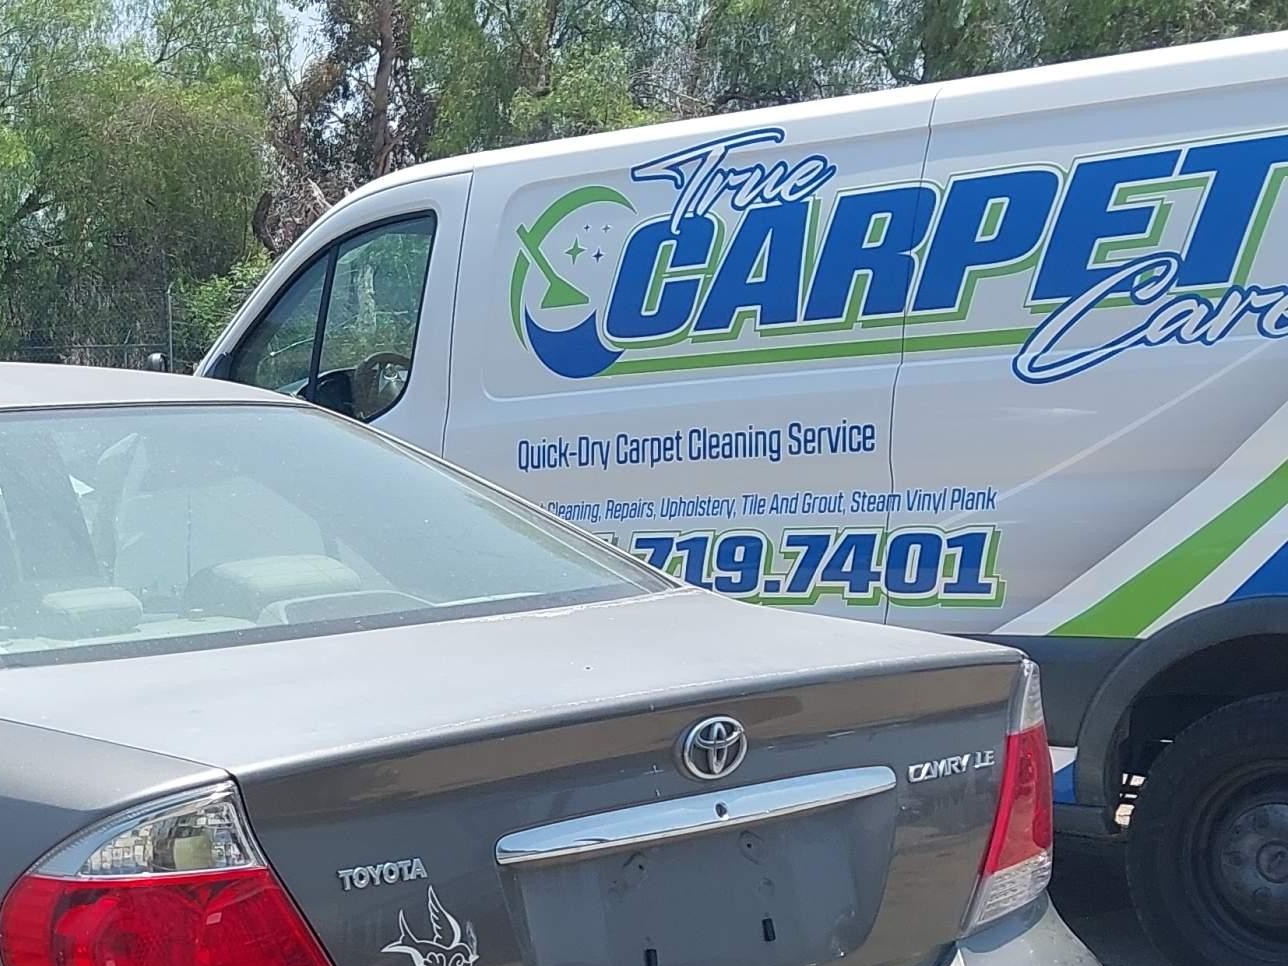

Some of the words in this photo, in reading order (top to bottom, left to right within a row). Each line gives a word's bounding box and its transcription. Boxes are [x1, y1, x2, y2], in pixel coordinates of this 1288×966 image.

[632, 128, 836, 234] True
[604, 132, 1288, 350] CARPET
[517, 436, 611, 472] Quick-Dry
[616, 431, 682, 467] Carpet
[688, 425, 781, 461] Cleaning
[787, 420, 876, 456] Service
[605, 499, 656, 521] Repairs,
[660, 495, 736, 520] Upholstery,
[741, 493, 766, 515] Tile
[768, 491, 800, 515] And
[801, 490, 847, 515] Grout,
[850, 490, 901, 513] Steam
[905, 487, 948, 514] Vinyl
[950, 486, 998, 511] Plank
[908, 753, 971, 783] CAMRY
[974, 750, 996, 768] LE
[337, 858, 428, 891] TOYOTA
